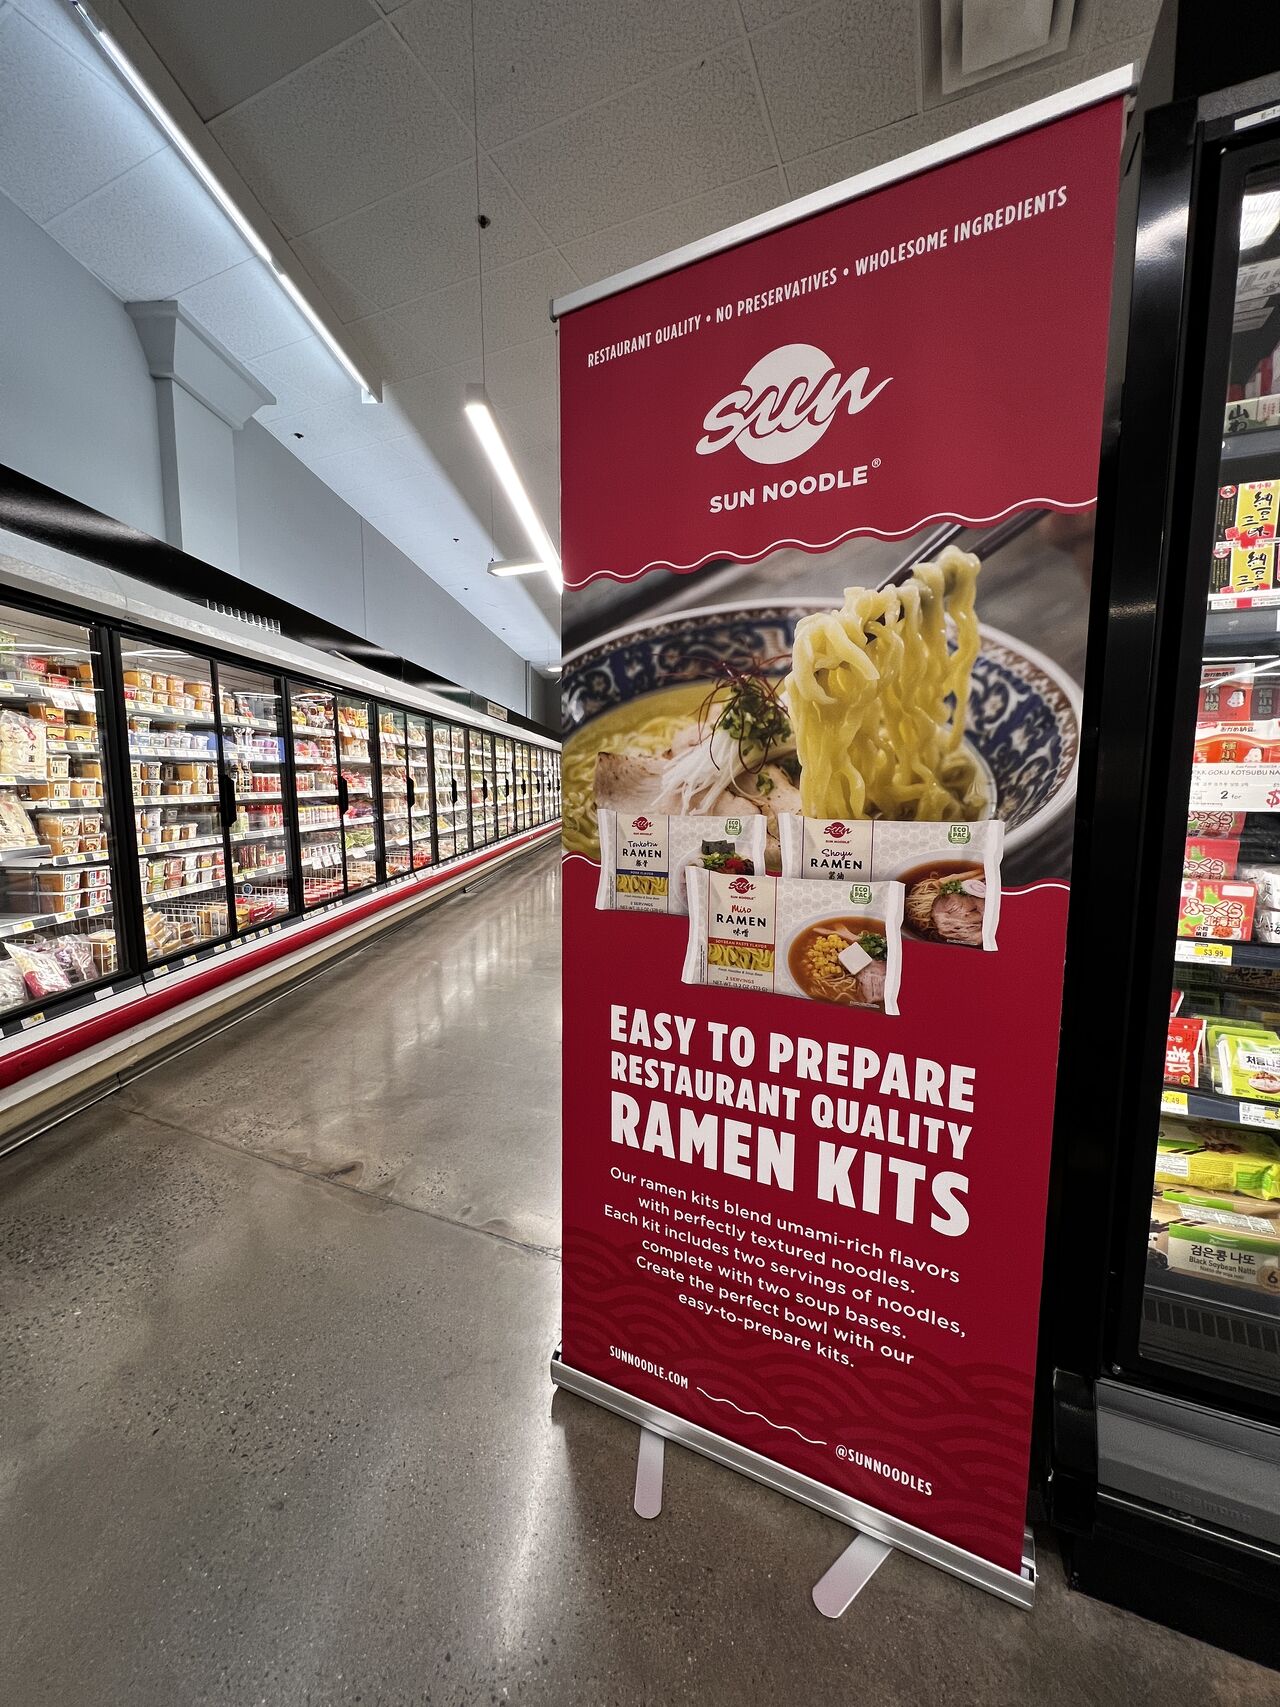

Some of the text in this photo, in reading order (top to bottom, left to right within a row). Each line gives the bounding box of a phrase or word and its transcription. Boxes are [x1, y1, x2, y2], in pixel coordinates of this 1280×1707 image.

[587, 185, 1067, 368] RESTAURANT QUALITY NO PRESERVATIVES WHOLESOME INGREDIENTS
[709, 487, 755, 514] SUN
[1220, 790, 1229, 800] 2
[622, 848, 662, 858] RAMEN
[810, 858, 863, 870] RAMEN
[821, 848, 853, 861] Shoyu
[716, 913, 767, 928] RAMEN
[731, 904, 752, 914] Miso
[1184, 897, 1243, 919] ふっくら
[729, 977, 755, 985] SERVINGS
[610, 1004, 976, 1113] EASY TO PREPARE
[611, 1050, 973, 1161] RESTAURANT QUALITY
[611, 1090, 970, 1237] RAMEN KITS
[610, 1166, 960, 1283] Our ramen kits blend umami-rich flavors
[638, 1197, 915, 1294] with perfectly textured noodles.
[1190, 1244, 1256, 1266] 검은콩 나또
[604, 1203, 966, 1338] Each kit includes two servings of noodles,
[1188, 1255, 1257, 1276] Black Soybean Natto
[1267, 1270, 1279, 1284] 6
[641, 1239, 906, 1340] complete with two soup bases.
[636, 1255, 915, 1365] Create the perfect bowl with our
[678, 1293, 855, 1368] easy-to-prepare kits.
[609, 1345, 689, 1390] SUNNOODLE.COM
[835, 1444, 933, 1496] @SUNNOODLES
